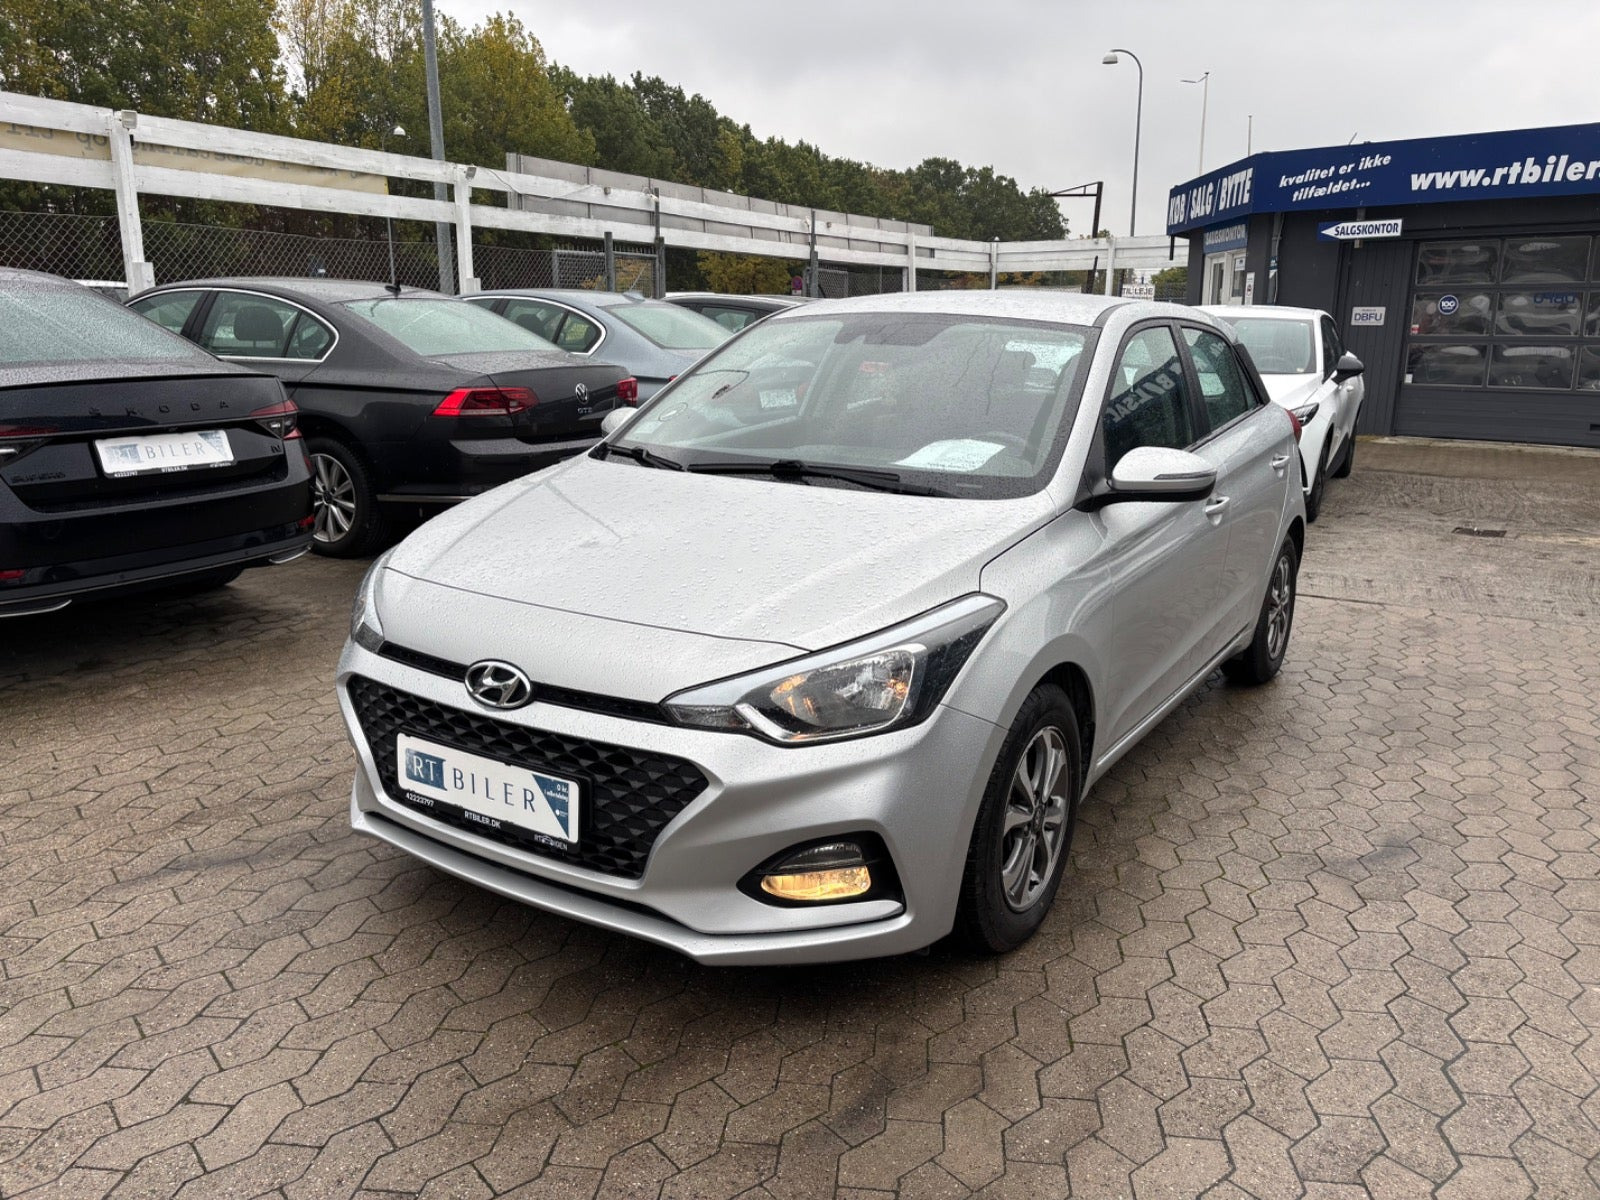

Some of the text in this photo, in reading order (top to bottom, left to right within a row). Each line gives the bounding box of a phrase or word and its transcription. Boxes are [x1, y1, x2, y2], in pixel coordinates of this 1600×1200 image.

[1279, 154, 1392, 188] kvalitet er ikke
[1410, 154, 1600, 191] www.rtbiler
[1190, 181, 1214, 220] SALG
[1219, 167, 1254, 211] BYTTE
[1292, 178, 1371, 202] tilfældet...
[1334, 222, 1399, 236] SALGSKONTOR
[1441, 300, 1456, 308] 100
[1354, 312, 1383, 322] DBFU
[145, 441, 207, 459] BILER
[412, 755, 536, 813] RT BILER
